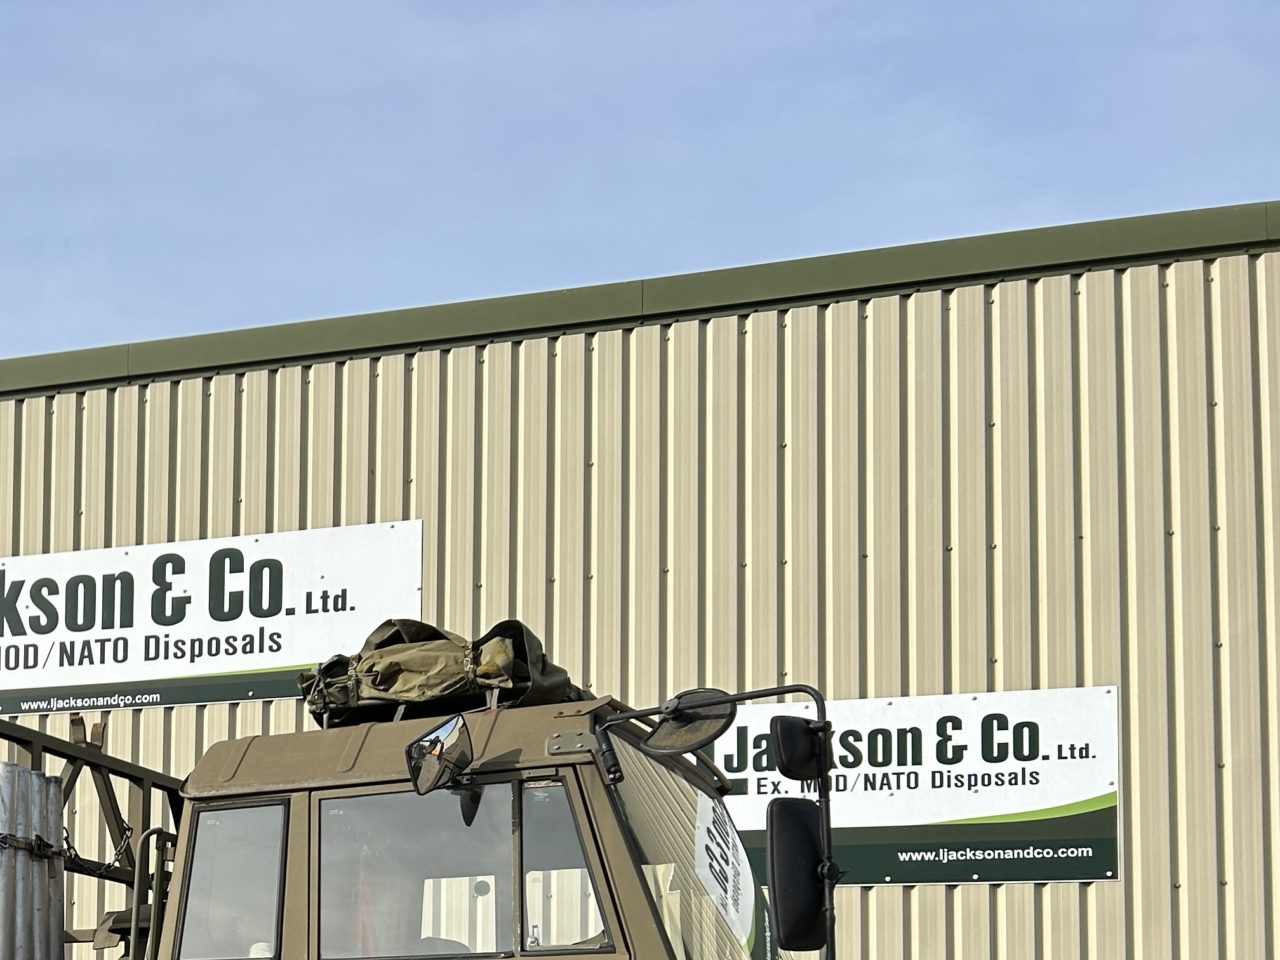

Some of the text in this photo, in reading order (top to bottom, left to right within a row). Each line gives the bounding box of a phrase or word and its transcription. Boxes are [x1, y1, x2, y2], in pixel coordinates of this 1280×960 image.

[151, 553, 192, 626] &
[208, 548, 296, 622] Co.
[306, 589, 356, 614] Ltd.
[144, 627, 282, 663] Disposals
[20, 693, 161, 711] www.ljacksonandco.com
[936, 715, 968, 765] &
[980, 713, 1050, 763] Co.
[1057, 743, 1097, 760] Ltd.
[757, 767, 1040, 795] Ex. MD/NATO Disposals
[898, 846, 1093, 864] www.ljacksonandco.com
